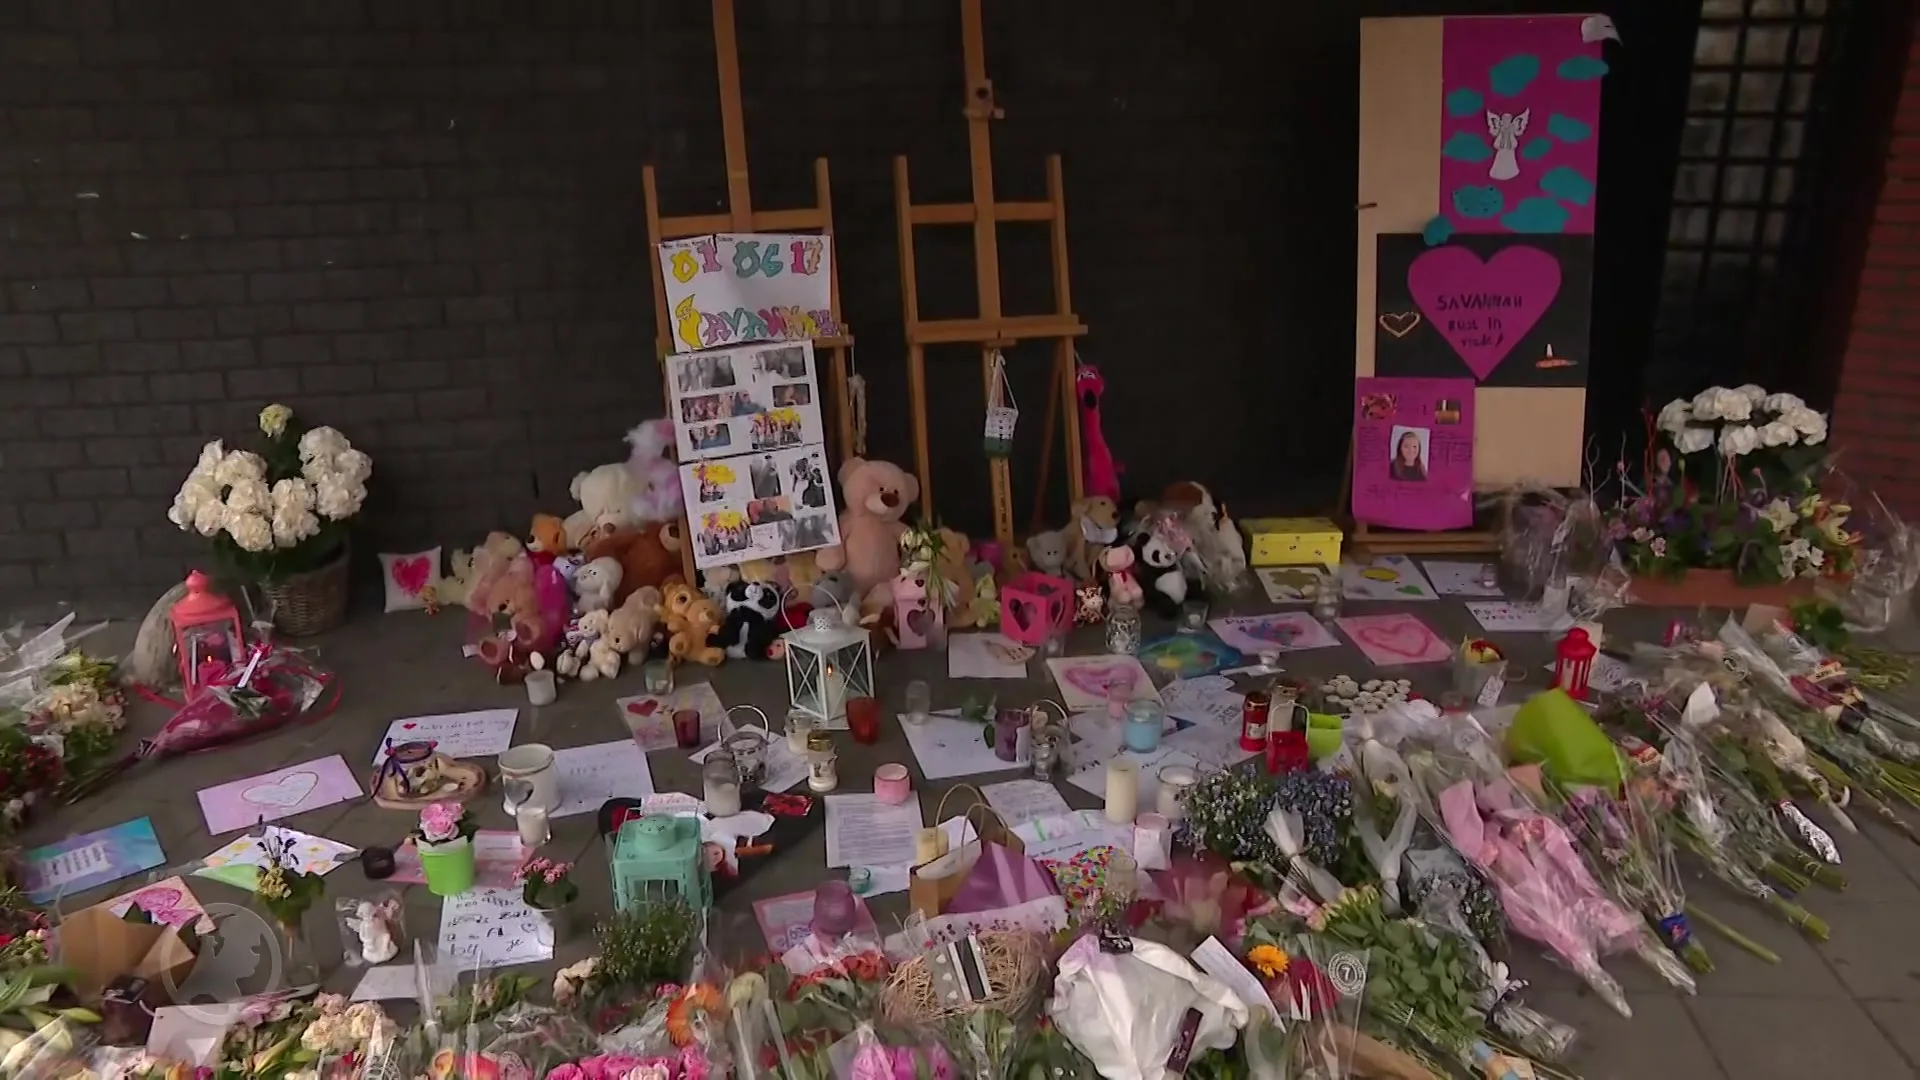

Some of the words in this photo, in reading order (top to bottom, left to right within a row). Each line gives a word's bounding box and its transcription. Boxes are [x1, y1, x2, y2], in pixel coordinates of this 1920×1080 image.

[670, 239, 723, 283] 01
[733, 241, 783, 278] 06
[790, 238, 824, 275] 17
[1341, 966, 1351, 980] 7
